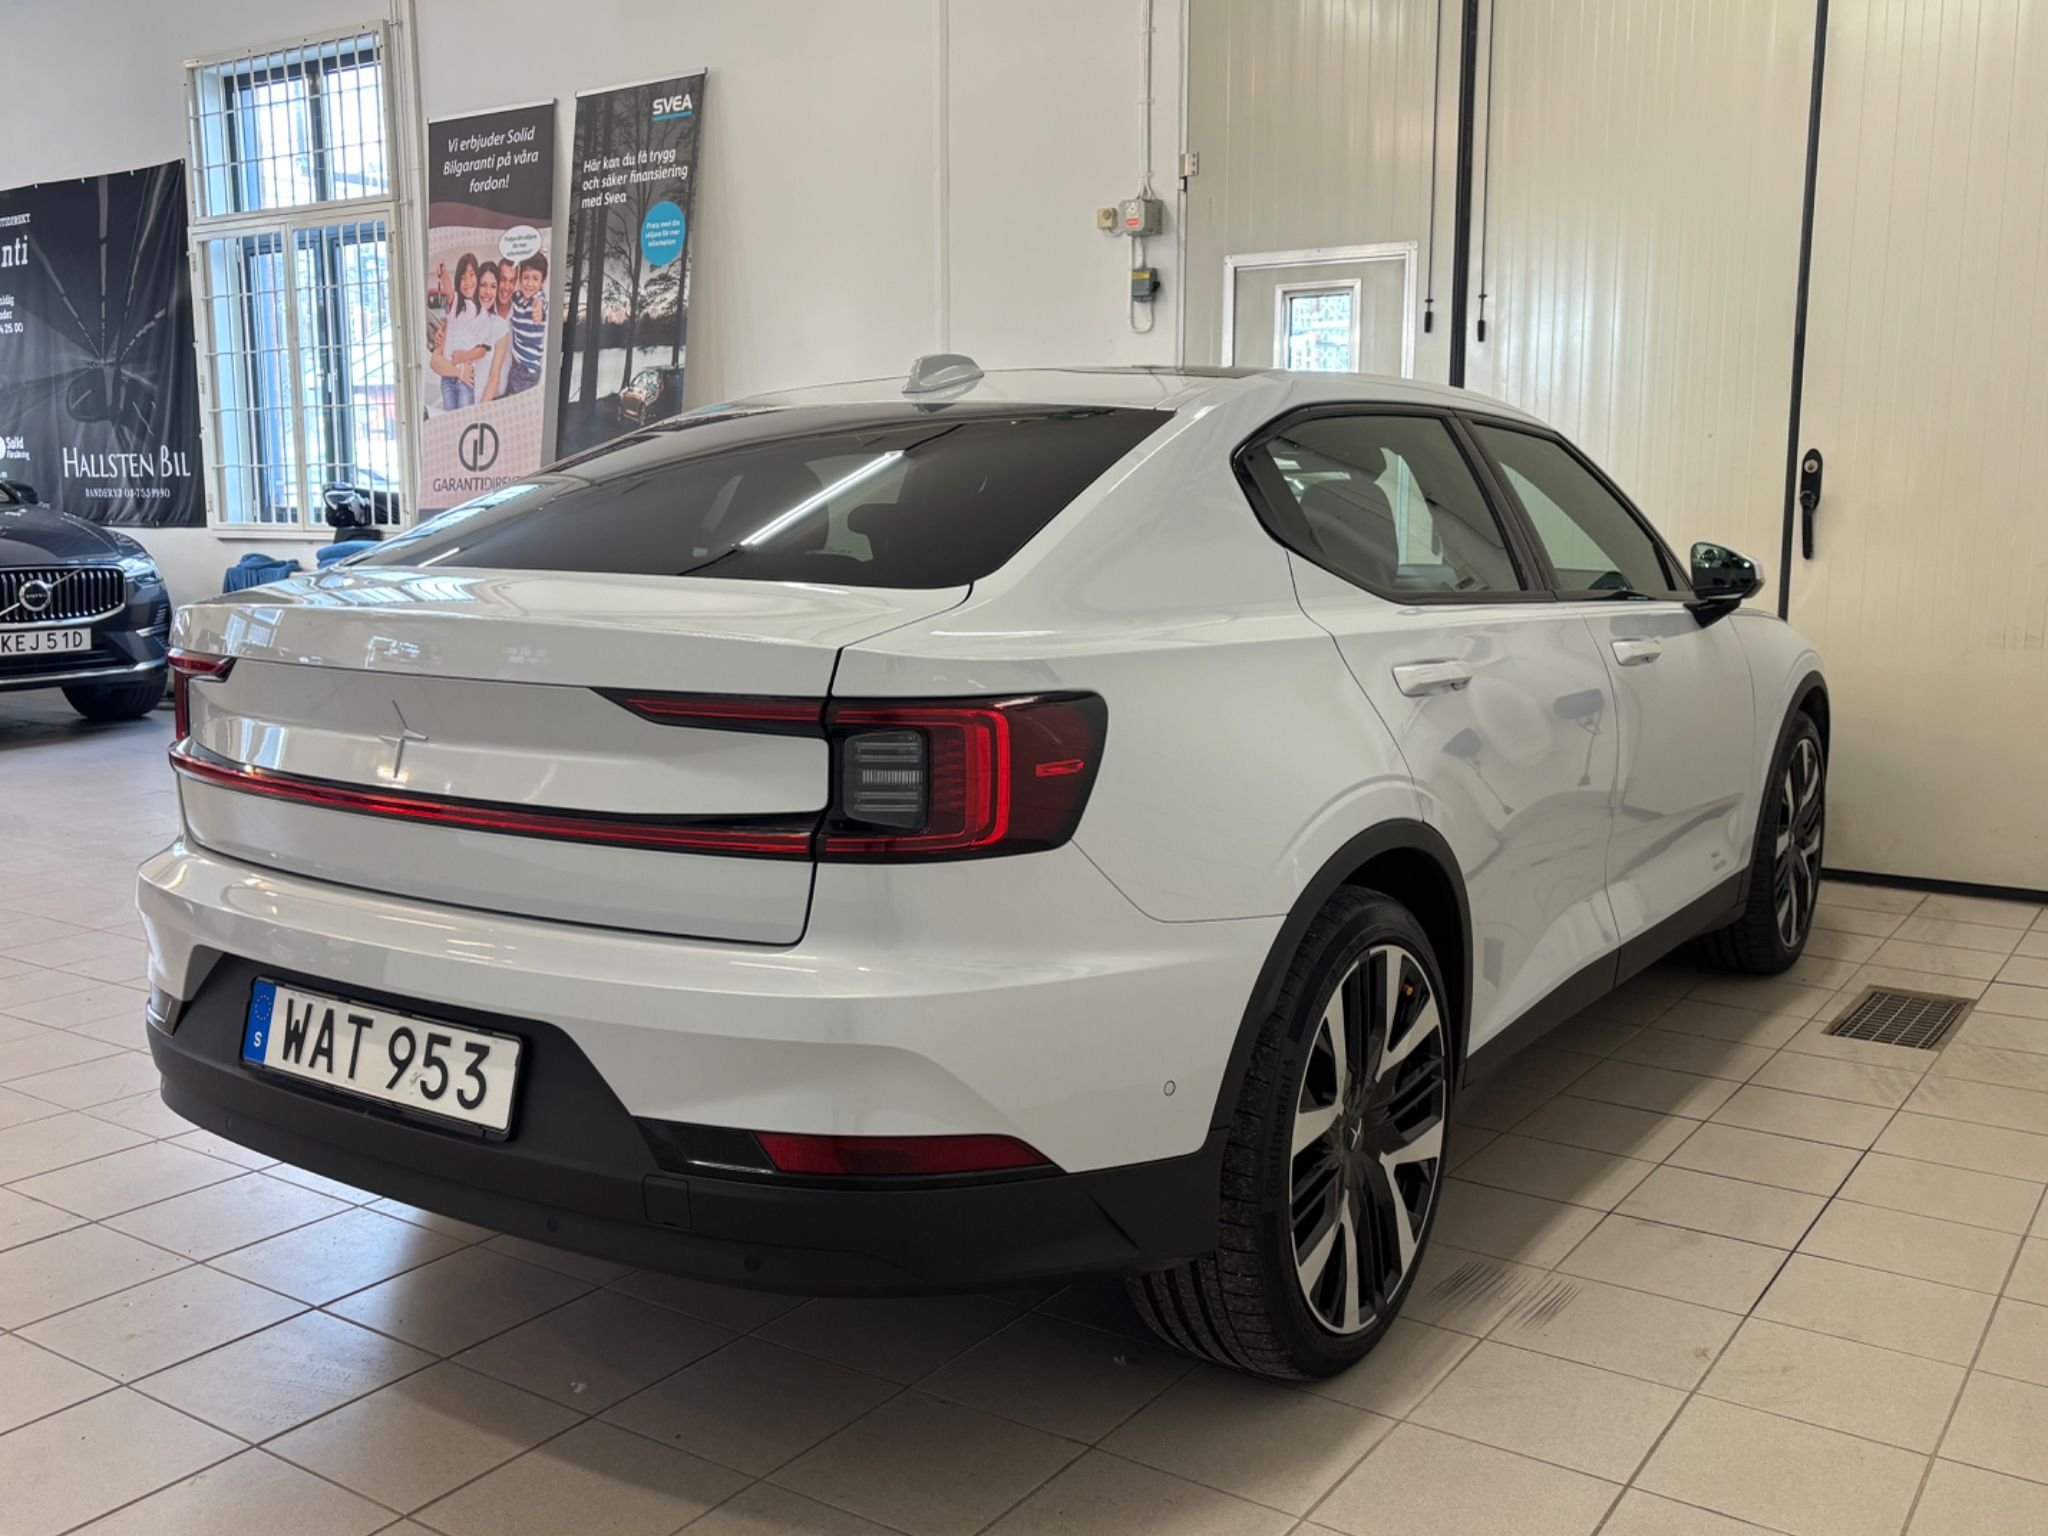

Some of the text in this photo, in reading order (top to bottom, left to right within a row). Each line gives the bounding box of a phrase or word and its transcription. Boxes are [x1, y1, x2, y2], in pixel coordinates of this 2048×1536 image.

[652, 93, 693, 115] SVEA
[448, 124, 536, 152] Vi erbjuder Solid
[443, 148, 539, 177] Bilgaranti på våra
[583, 149, 676, 173] Här kan du få trygg
[469, 173, 511, 193] fordon!
[582, 164, 688, 191] och säker finansiering
[581, 192, 627, 208] med Svea
[5, 436, 24, 449] Solid
[62, 444, 191, 478] HALLSTEN BIL
[1, 634, 40, 653] KEJ
[253, 1031, 263, 1048] S
[282, 998, 491, 1110] WAT 953
